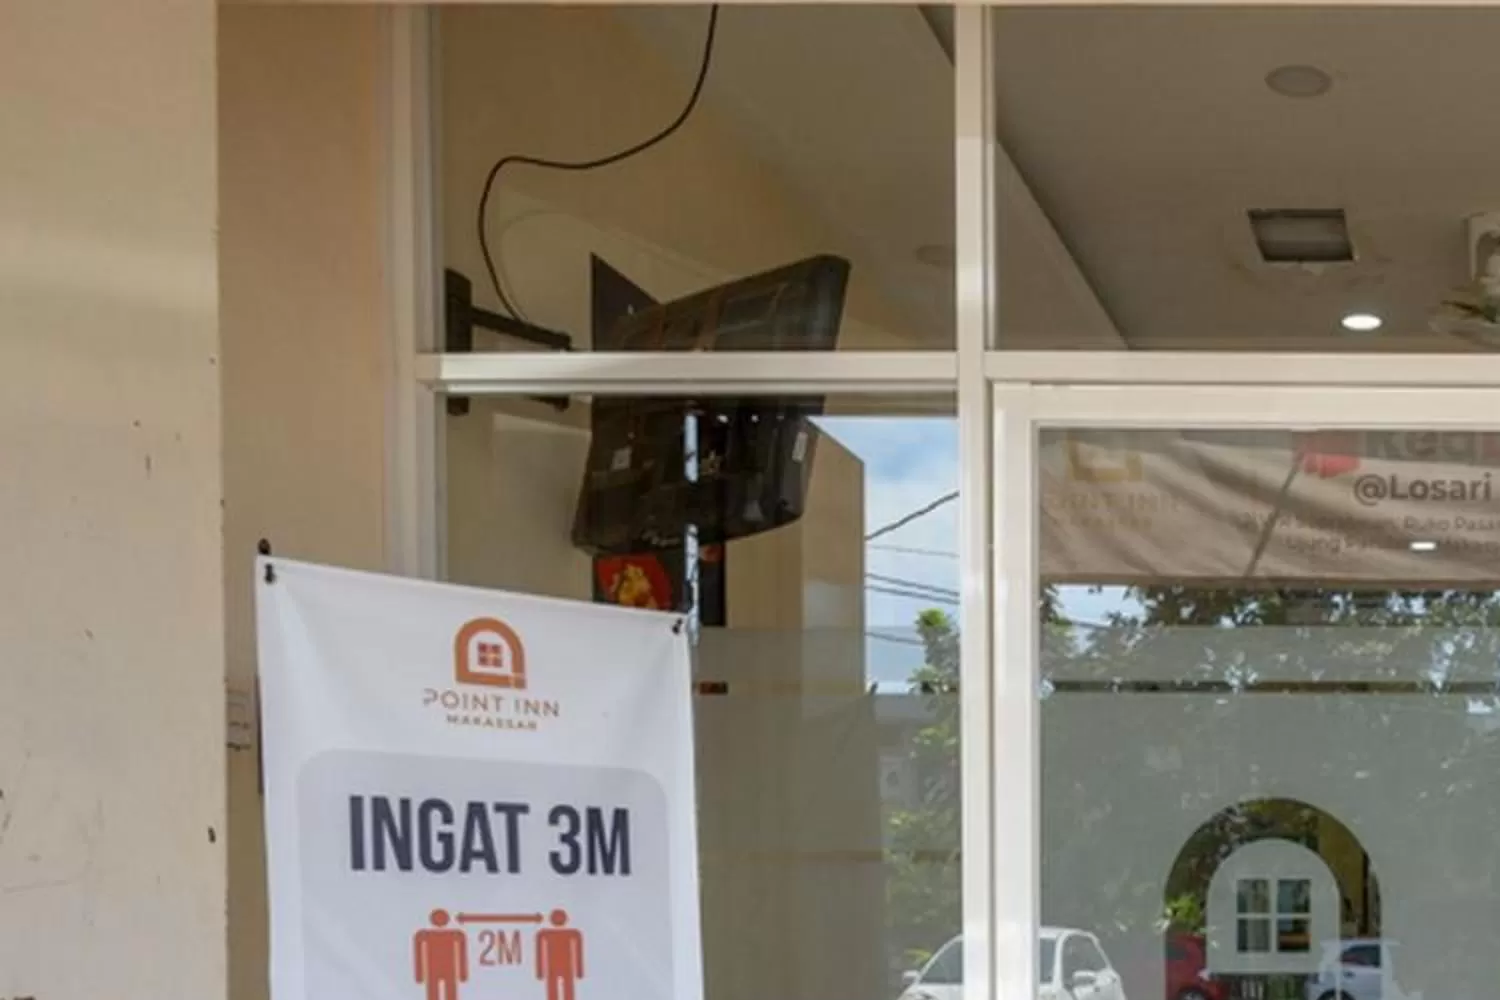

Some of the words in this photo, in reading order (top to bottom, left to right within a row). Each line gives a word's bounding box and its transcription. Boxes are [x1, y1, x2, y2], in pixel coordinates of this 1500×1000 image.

[1353, 472, 1493, 507] @Losari
[422, 687, 504, 712] POINT
[515, 698, 560, 717] INN
[446, 713, 538, 731] MAKASSAR
[350, 794, 530, 874] INGAT
[547, 804, 631, 877] 3M
[477, 928, 523, 966] 2M
